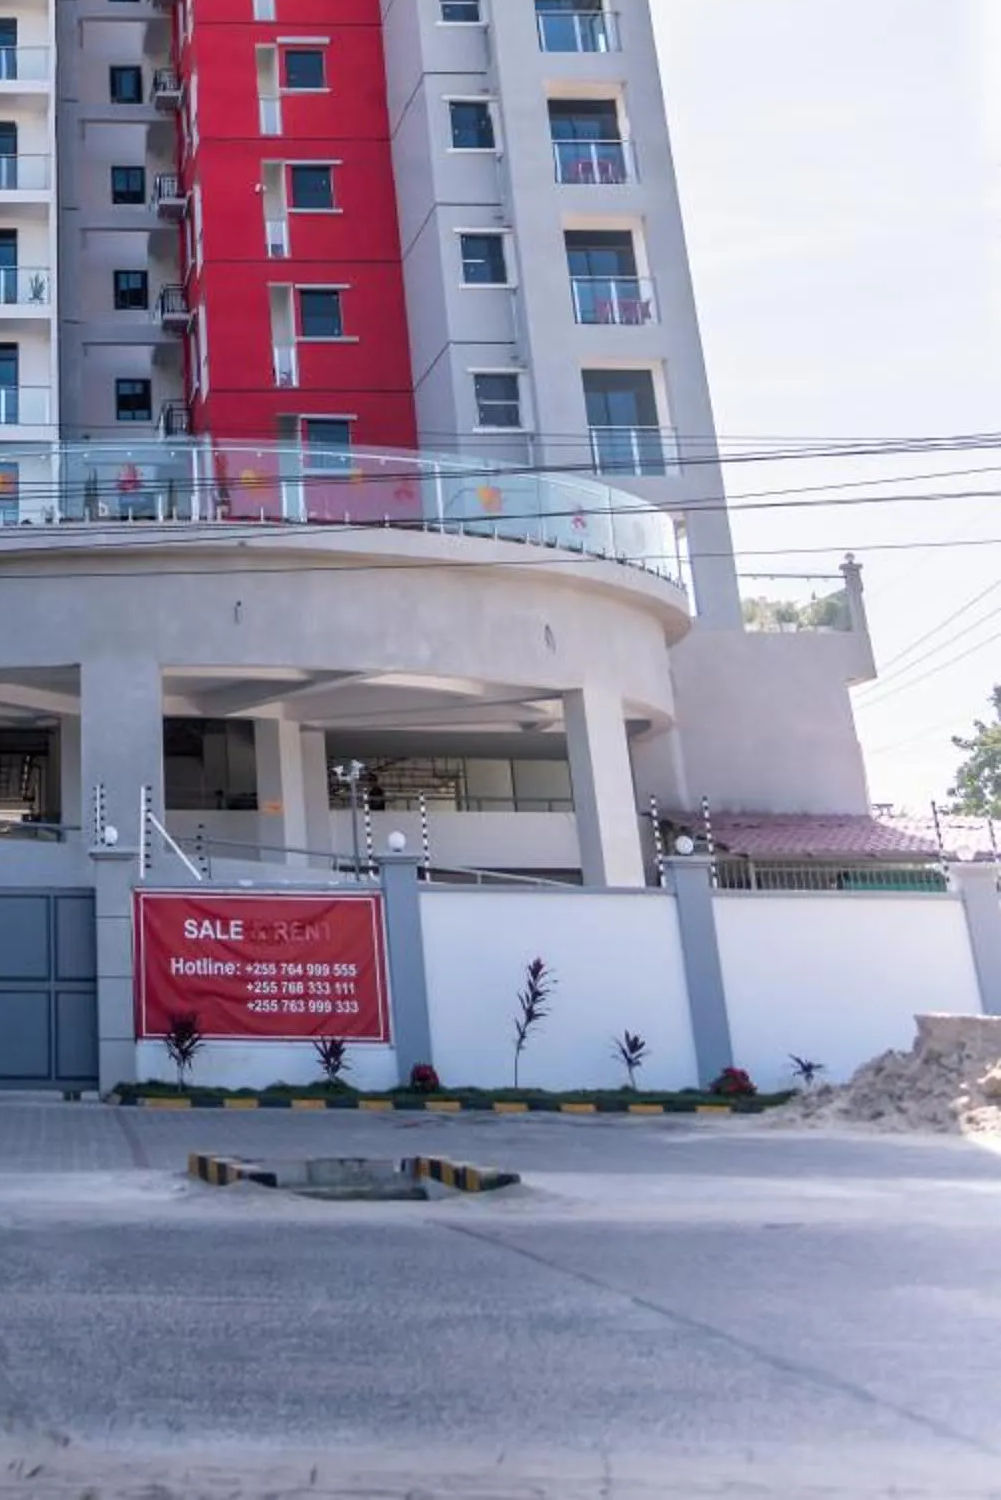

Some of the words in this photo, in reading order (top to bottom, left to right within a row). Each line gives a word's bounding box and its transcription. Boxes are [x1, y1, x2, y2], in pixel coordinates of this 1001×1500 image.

[183, 919, 245, 941] SALE
[170, 957, 241, 976] Hotline:
[245, 963, 277, 976] +255
[280, 963, 303, 976] 764
[306, 963, 330, 977] 999
[333, 963, 357, 977] 555
[246, 981, 278, 994] +255
[307, 981, 332, 995] 333
[334, 981, 355, 995] 111
[246, 999, 278, 1013] +255
[308, 999, 332, 1013] 999
[335, 1000, 359, 1013] 333
